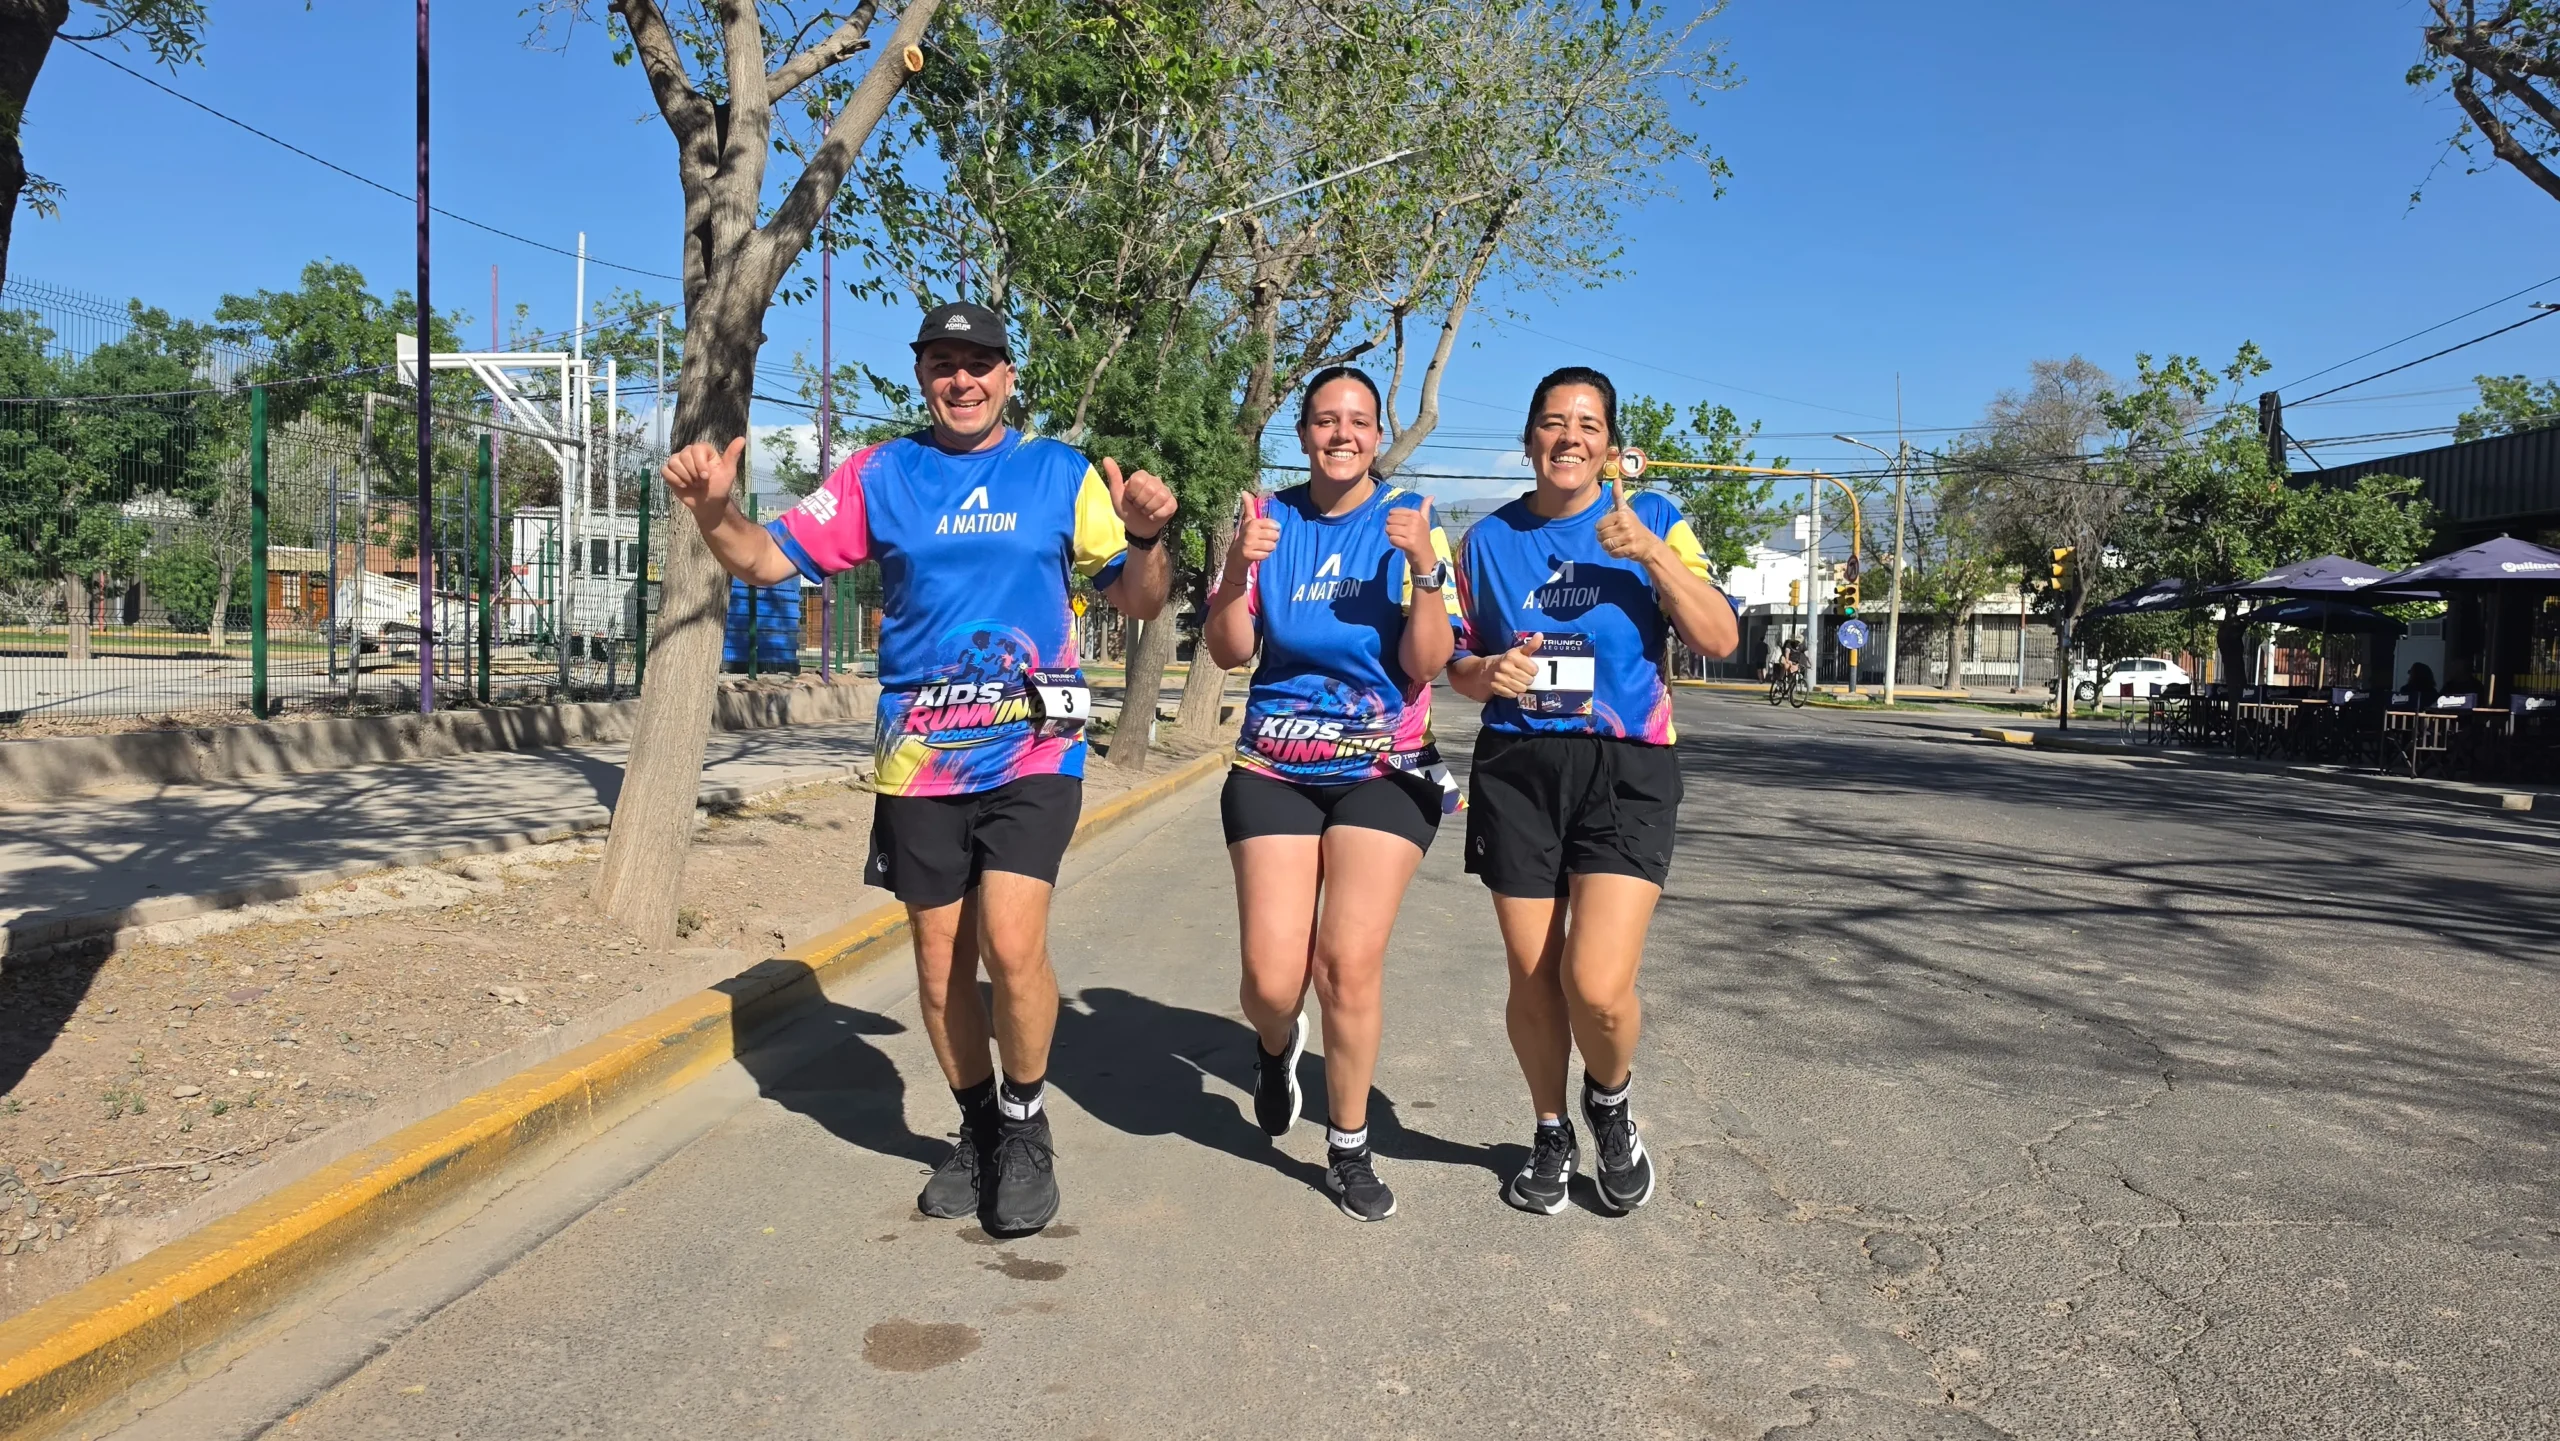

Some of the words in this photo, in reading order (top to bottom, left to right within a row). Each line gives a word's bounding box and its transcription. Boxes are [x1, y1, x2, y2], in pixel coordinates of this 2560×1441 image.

[935, 514, 948, 534] A
[952, 512, 1017, 534] NATION
[1292, 584, 1306, 601] A
[1306, 579, 1362, 601] NATION
[1522, 590, 1534, 609] A
[1538, 586, 1600, 609] NATION
[1548, 660, 1558, 685] 1
[914, 682, 1004, 706] KIDS
[1061, 689, 1074, 713] 3
[927, 721, 1028, 743] DORREGO
[1258, 716, 1344, 740] KIDS
[1337, 1133, 1366, 1145] RUFUS
